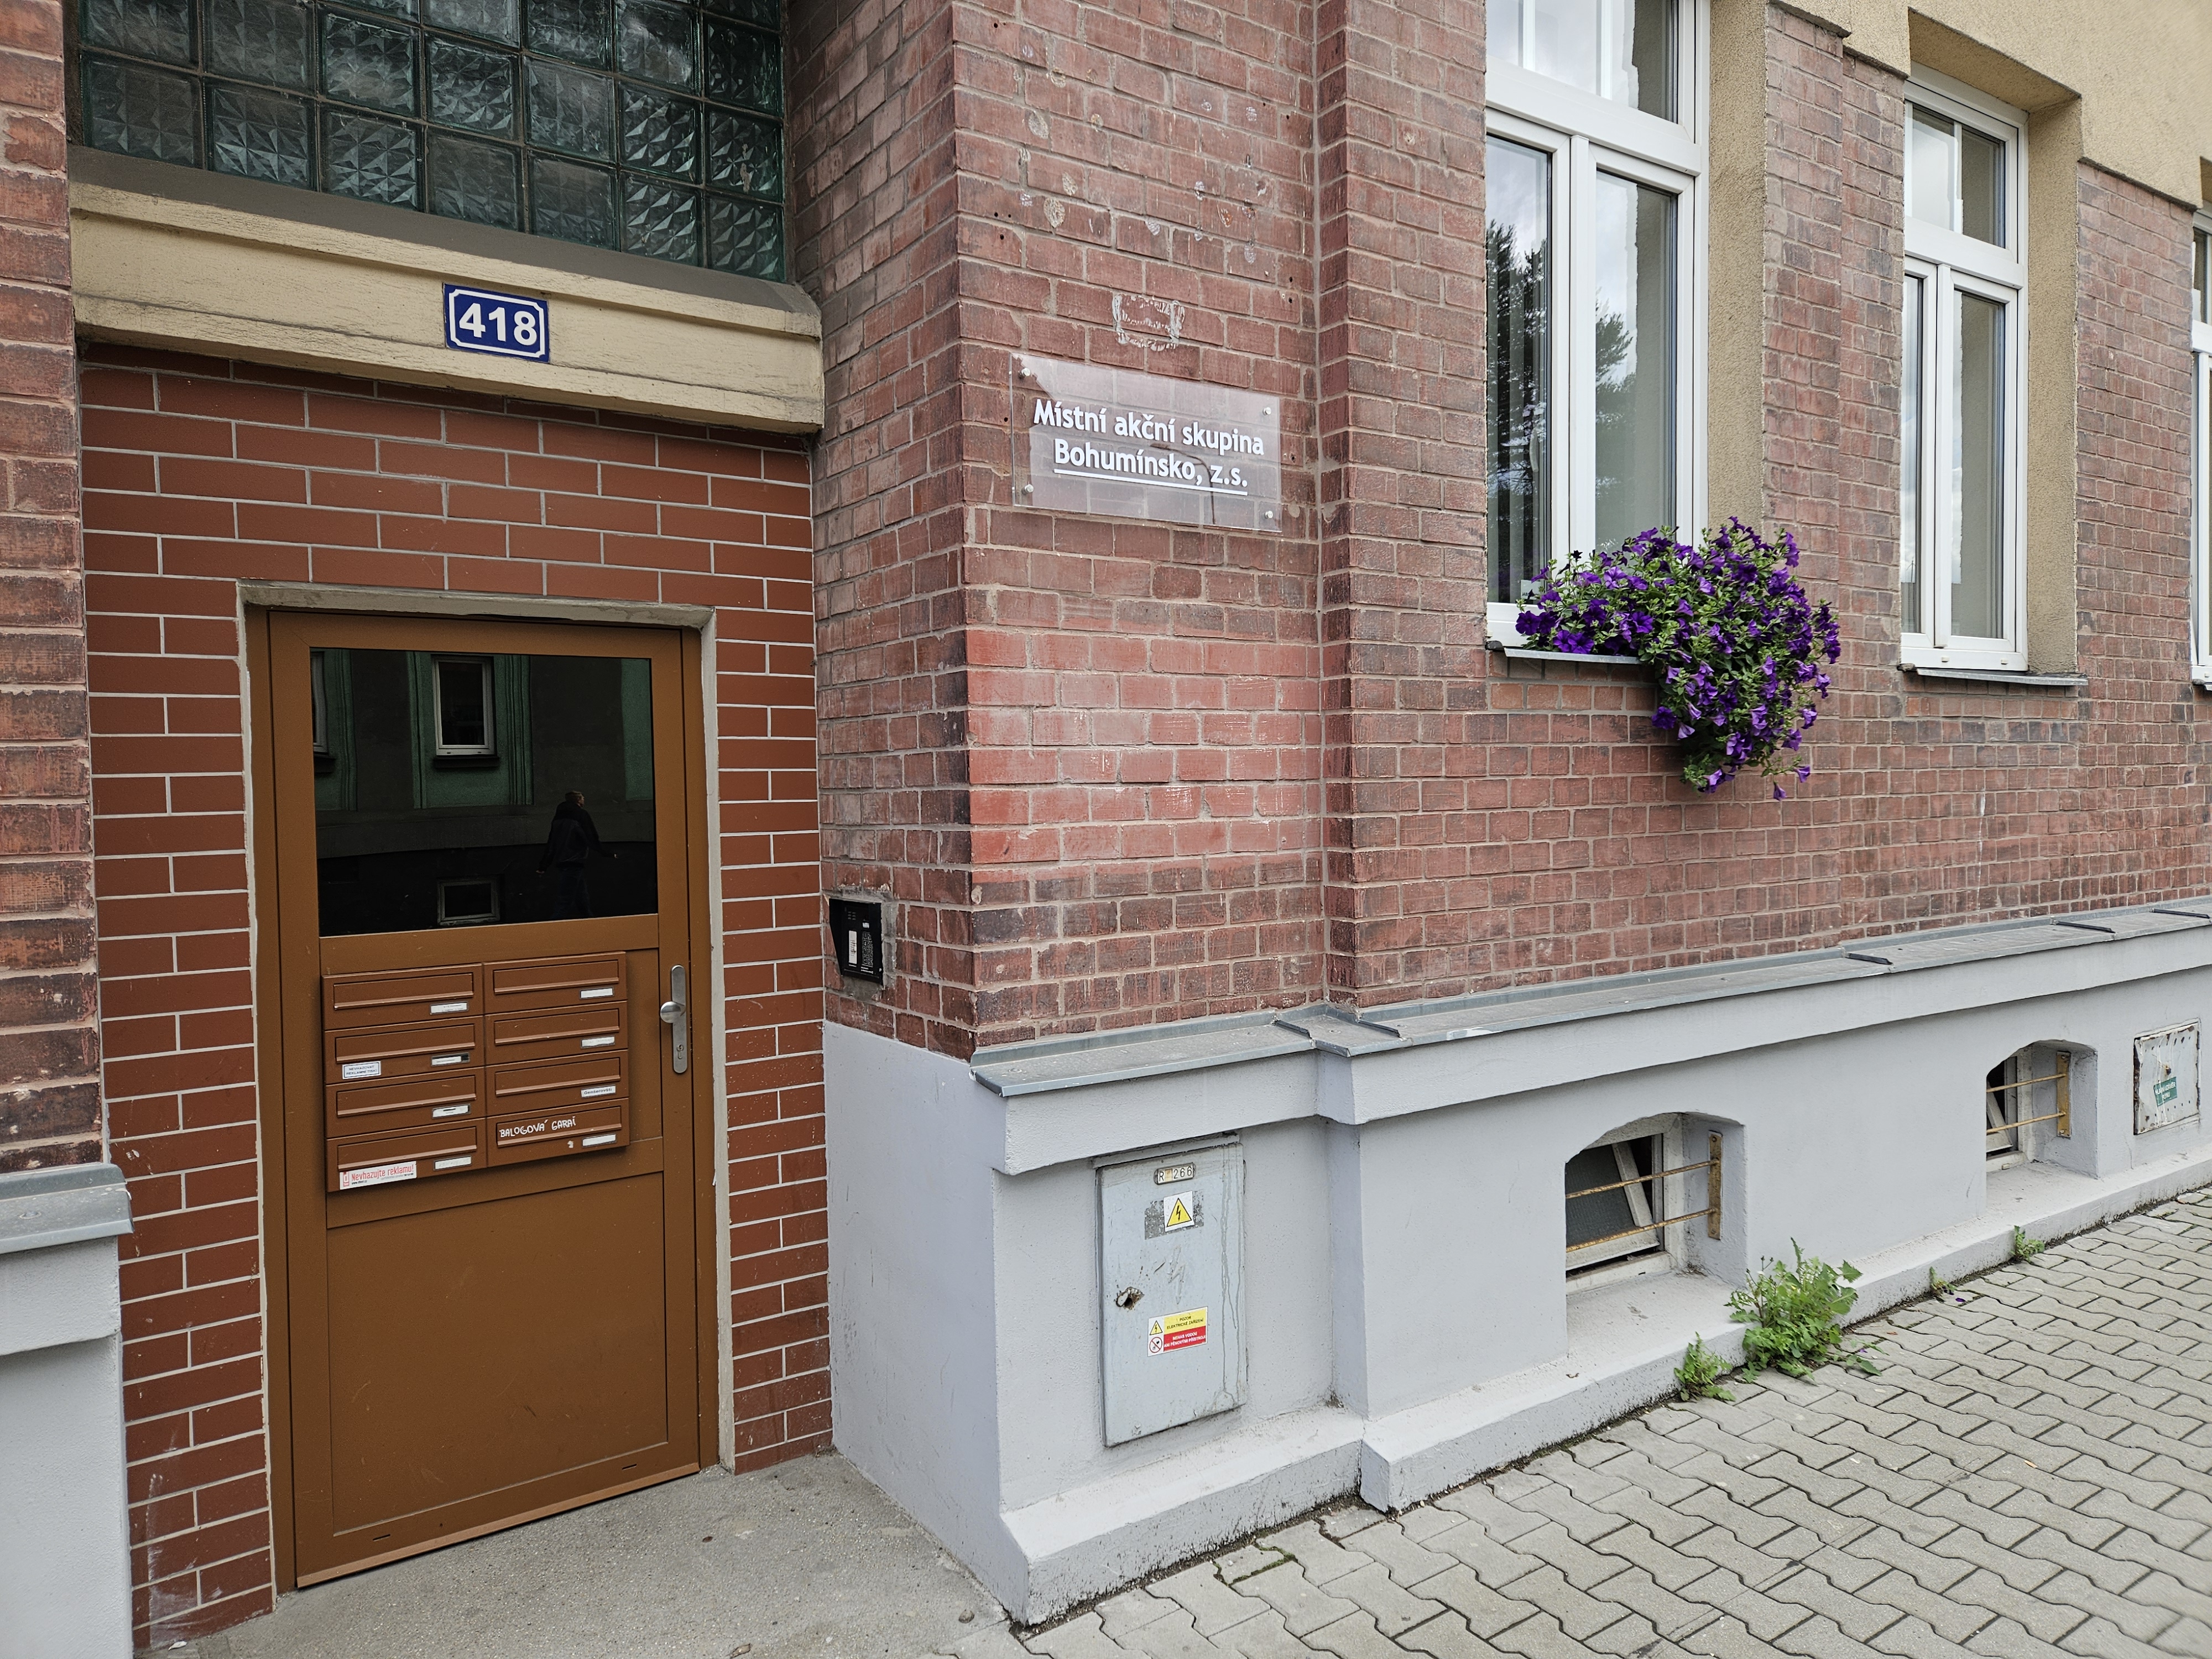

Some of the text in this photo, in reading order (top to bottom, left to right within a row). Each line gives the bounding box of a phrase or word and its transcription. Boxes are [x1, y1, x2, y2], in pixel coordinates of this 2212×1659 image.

[459, 302, 538, 346] 418
[1034, 398, 1265, 456] Místní akční skupina
[1054, 438, 1248, 488] Bohumínsko, z.s.
[499, 1119, 549, 1138] BALOGOVÁ
[351, 1170, 385, 1182] Nevhazujte
[388, 1164, 414, 1176] reklamu!
[1159, 1166, 1192, 1182] R 266
[1167, 1321, 1188, 1329] ELEKTRICKÉ
